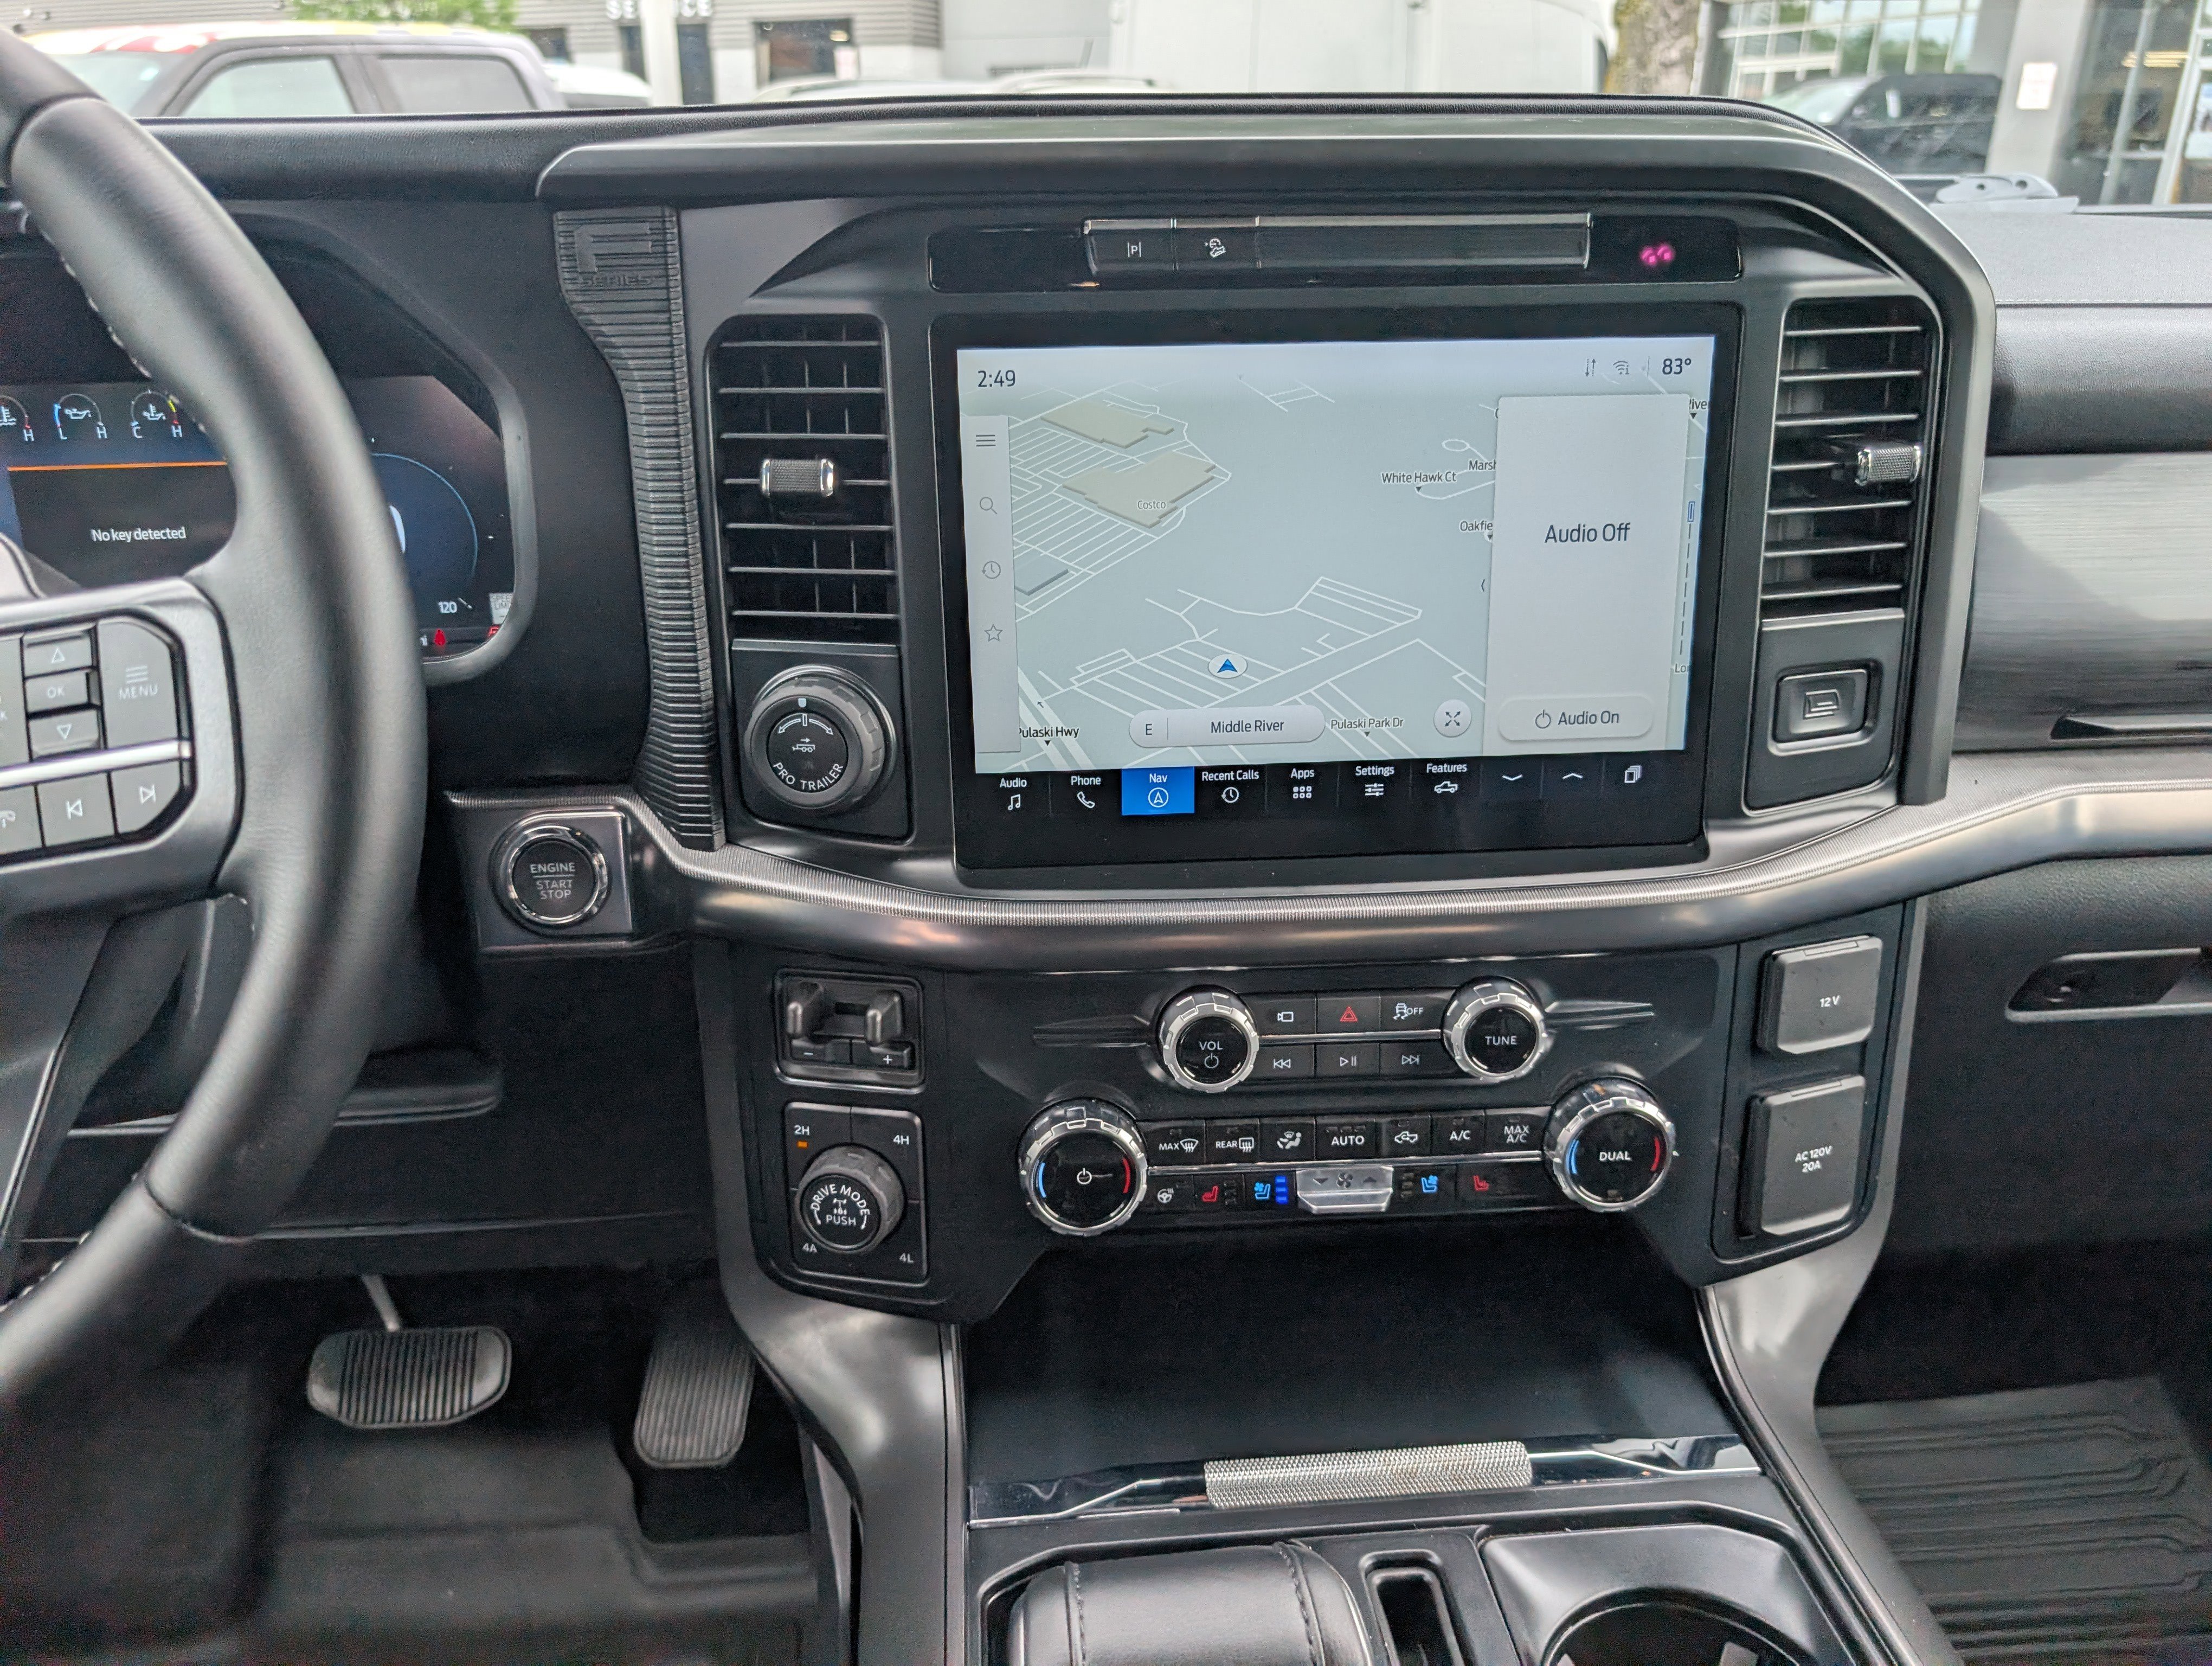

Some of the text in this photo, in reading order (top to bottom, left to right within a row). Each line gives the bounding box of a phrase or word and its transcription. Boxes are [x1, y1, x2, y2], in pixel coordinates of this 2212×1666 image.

[1662, 357, 1692, 375] 83°
[978, 369, 1016, 388] 2:49
[23, 429, 34, 441] H
[96, 426, 107, 439] H
[133, 426, 143, 439] C
[171, 425, 183, 437] H
[1381, 471, 1457, 484] White Hawk Ct
[1137, 499, 1167, 510] Costco
[91, 526, 187, 543] No key detected
[1544, 522, 1630, 543] Audio Off
[438, 601, 458, 613] 120
[47, 686, 65, 699] OK
[119, 685, 158, 700] MENU
[1330, 717, 1404, 729] Pulaski Park Dr
[1558, 710, 1619, 726] Audio On
[1145, 723, 1153, 735] E
[1210, 719, 1284, 733] Middle River
[1056, 726, 1079, 739] Hwy
[1355, 764, 1394, 777] Settings
[1426, 762, 1468, 773] Features
[773, 762, 844, 791] PRO TRAILER
[1149, 773, 1168, 783] Nav
[1201, 769, 1259, 781] Recent Calls
[1290, 768, 1315, 780] Apps
[999, 777, 1027, 788] Audio
[1070, 776, 1101, 786] Phone
[530, 862, 576, 874] ENGINE
[536, 879, 573, 889] START
[540, 889, 571, 900] STOP
[1406, 1007, 1424, 1015] OFF
[1199, 1041, 1223, 1050] VOL
[1484, 1035, 1518, 1046] TUNE
[794, 1125, 810, 1136] 2H
[1449, 1130, 1471, 1140] A/C
[1504, 1124, 1530, 1135] MAX
[893, 1135, 910, 1145] 4H
[1215, 1140, 1238, 1149] REAR
[1331, 1135, 1365, 1146] AUTO
[1506, 1133, 1527, 1144] A/C
[1159, 1142, 1180, 1151] MAX
[1809, 1145, 1834, 1159] 120V
[1599, 1151, 1632, 1162] DUAL
[1802, 1160, 1822, 1173] 20A
[810, 1184, 870, 1216] DRIVE MODE
[826, 1215, 856, 1226] PUSH
[802, 1243, 817, 1253] 4A
[899, 1253, 914, 1263] 4L
